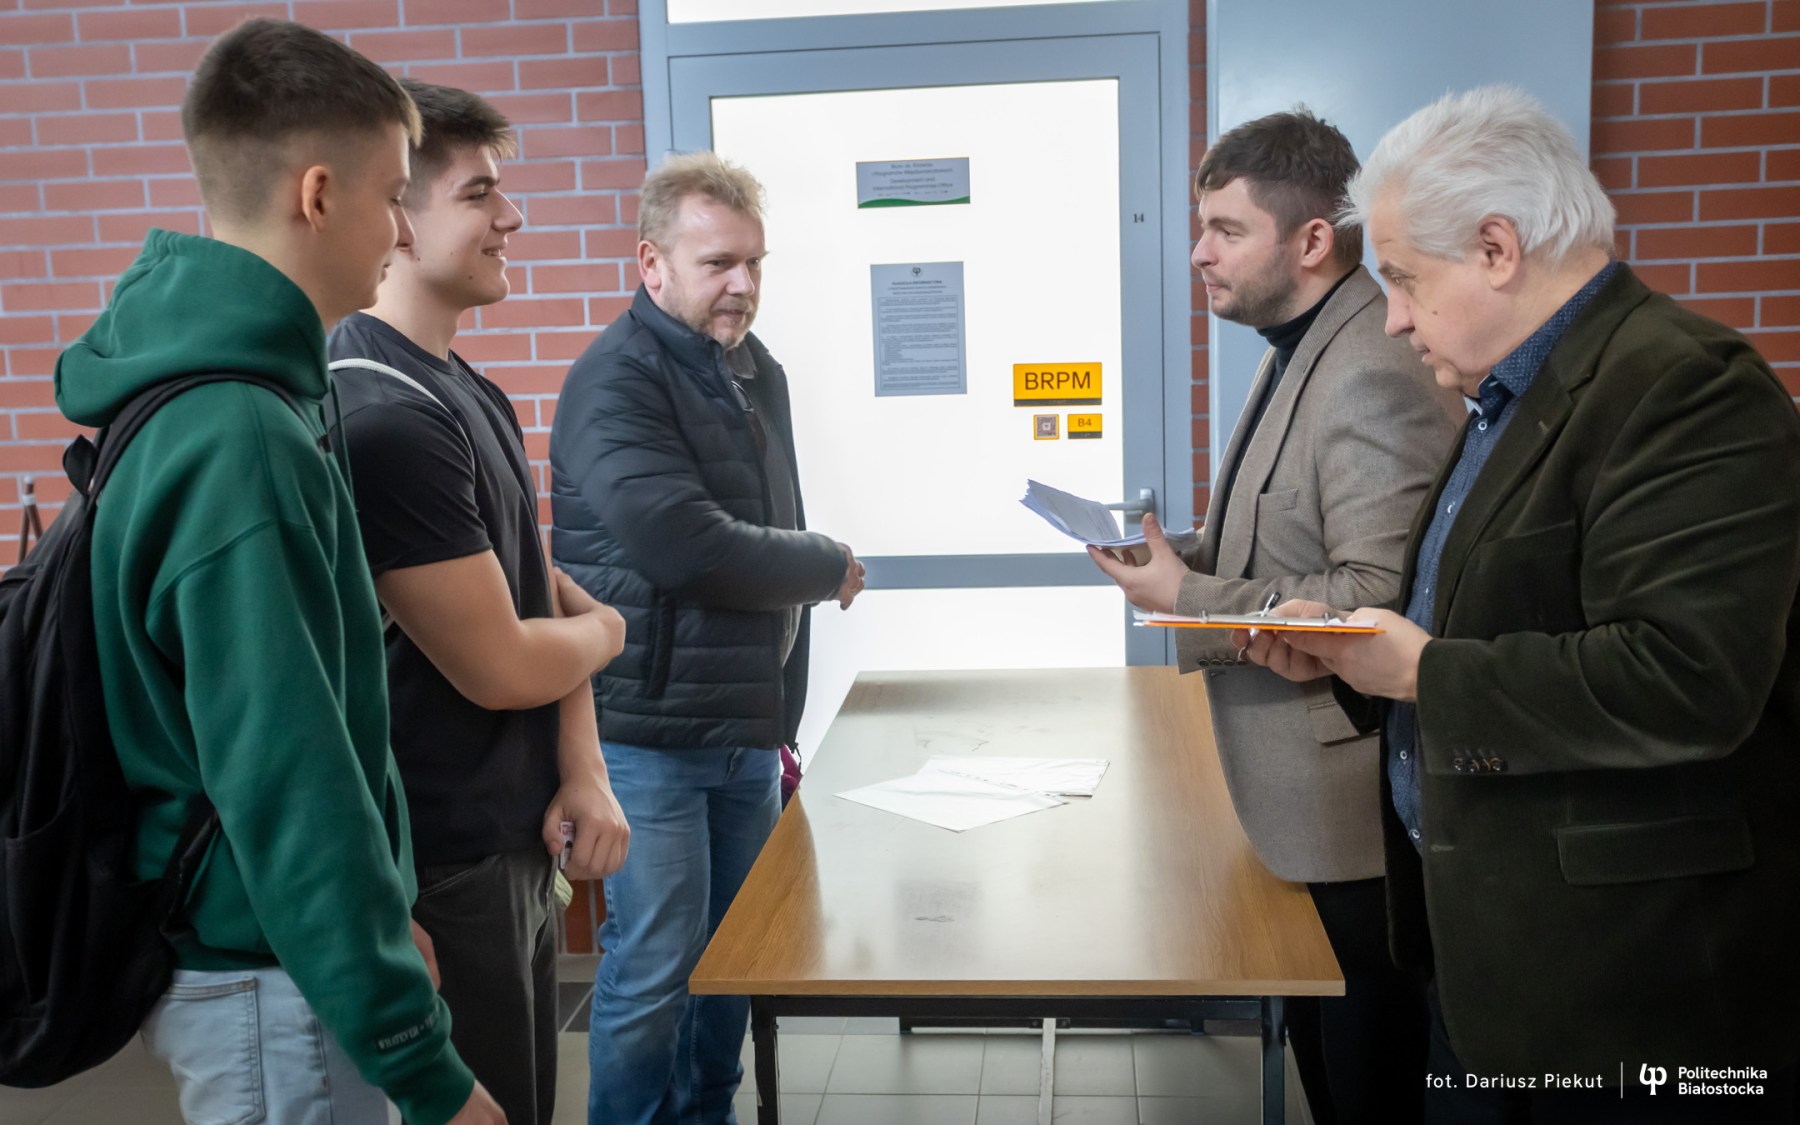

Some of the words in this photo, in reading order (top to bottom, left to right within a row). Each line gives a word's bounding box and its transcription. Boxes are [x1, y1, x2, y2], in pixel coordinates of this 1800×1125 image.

[1133, 213, 1144, 223] 14
[1025, 371, 1090, 390] BRPM
[1078, 418, 1092, 427] B4
